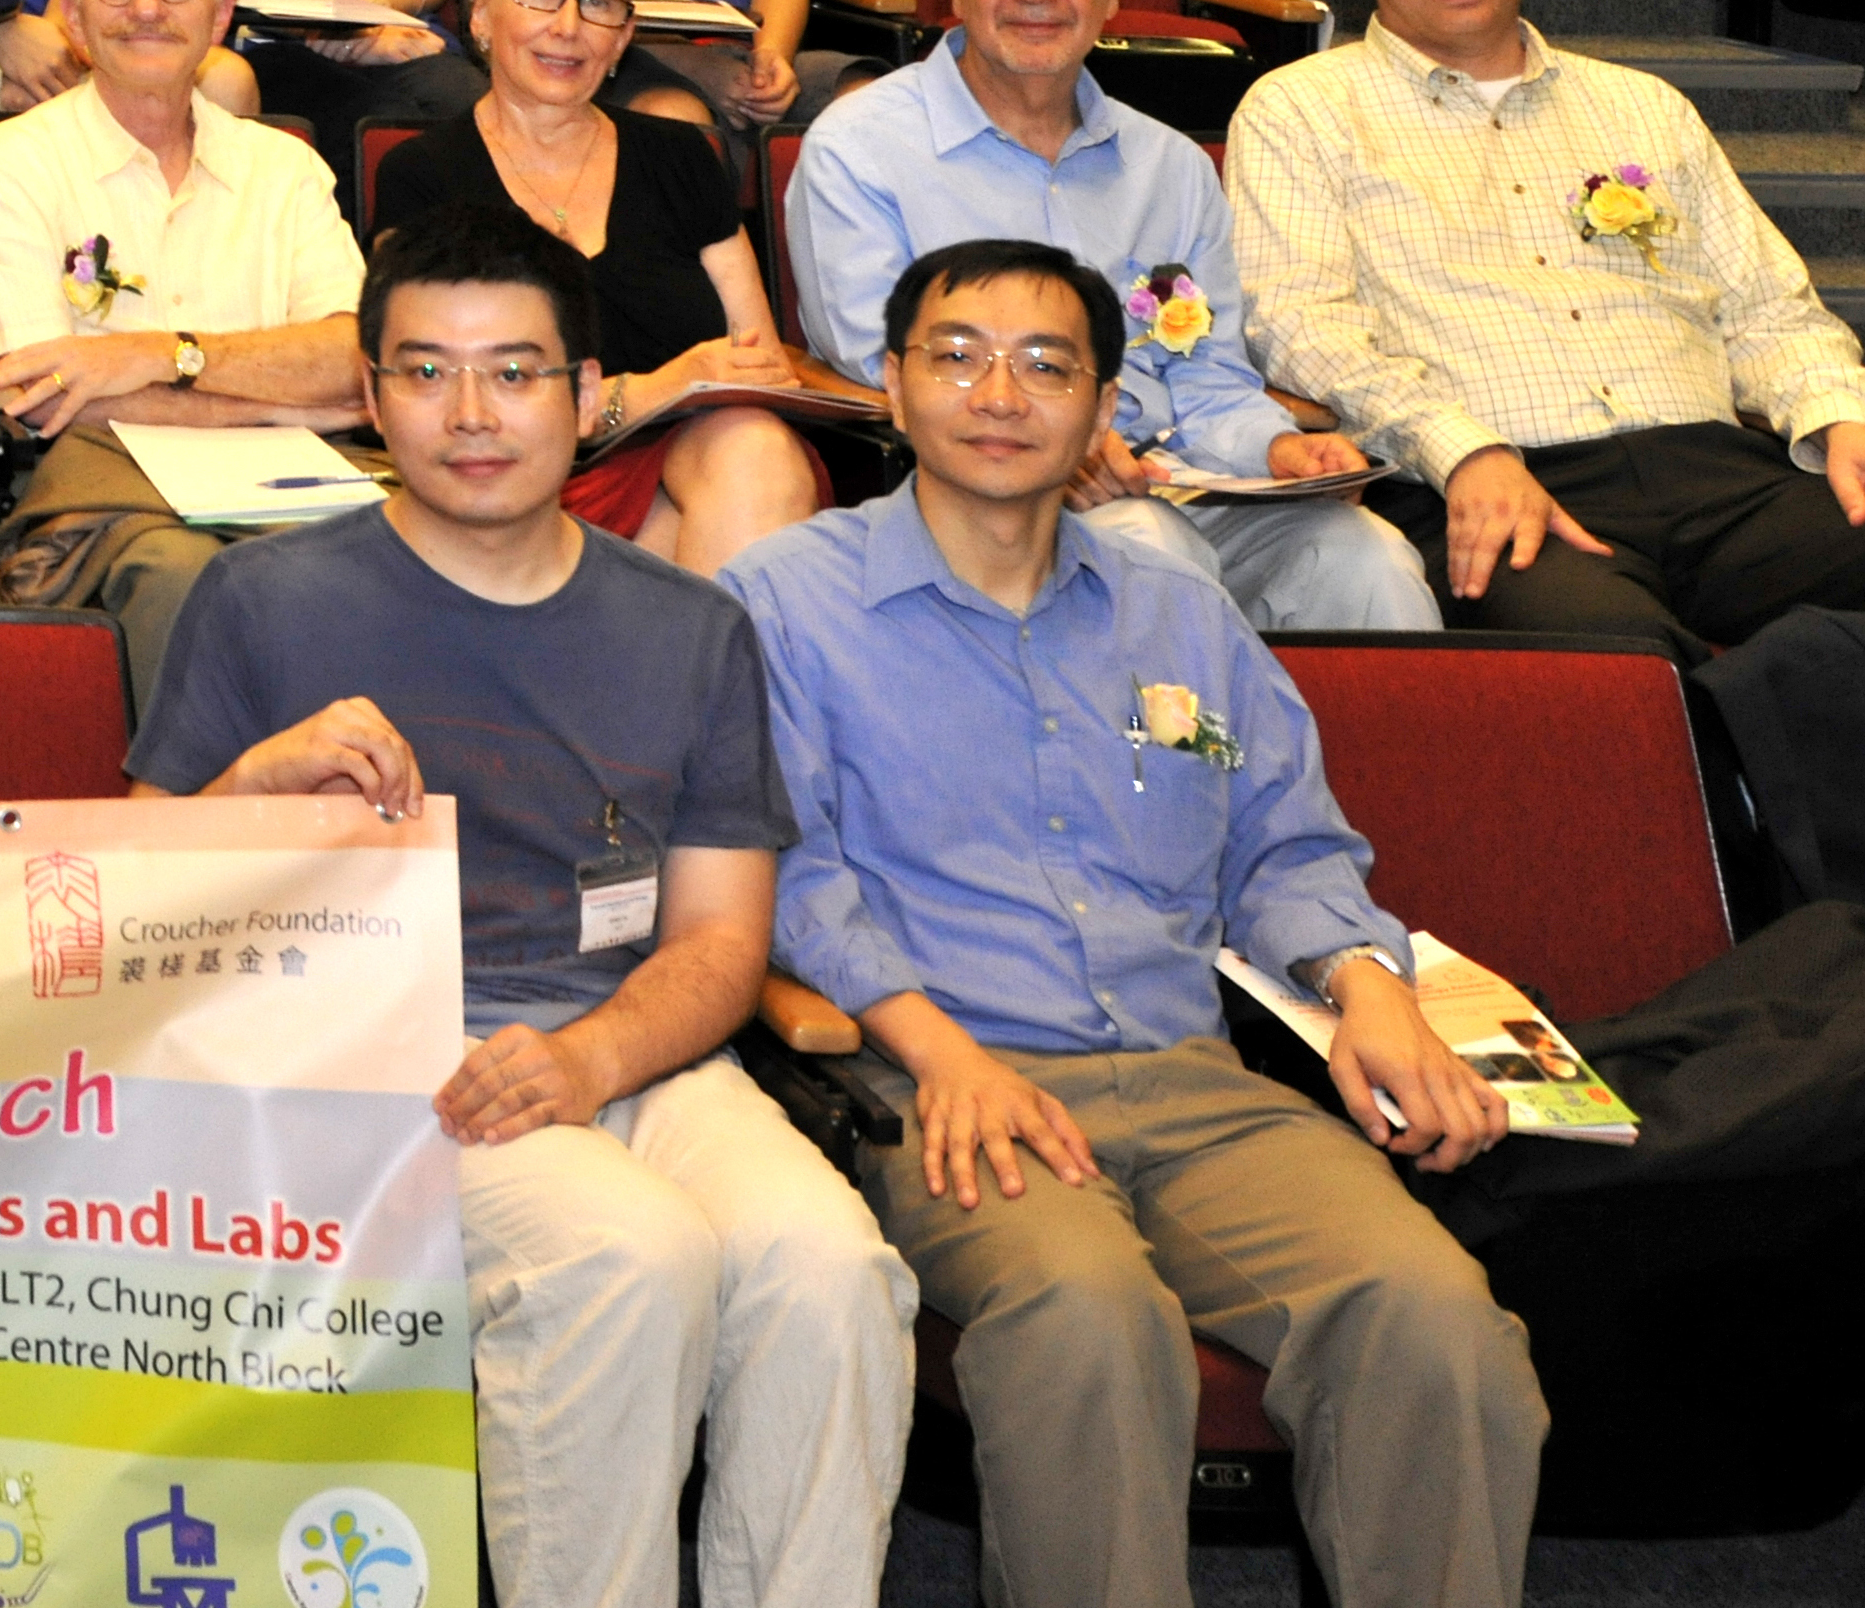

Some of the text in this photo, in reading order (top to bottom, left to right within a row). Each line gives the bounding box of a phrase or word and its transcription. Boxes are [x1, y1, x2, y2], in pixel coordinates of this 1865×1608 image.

[120, 906, 401, 943] Croucher Foundation
[44, 1189, 169, 1248] and
[192, 1195, 343, 1265] Labs
[1, 1271, 75, 1313] LT2,
[89, 1276, 212, 1330] Chung
[224, 1291, 284, 1330] Chi
[297, 1297, 444, 1346] College
[123, 1339, 227, 1385] North
[241, 1350, 349, 1395] Block
